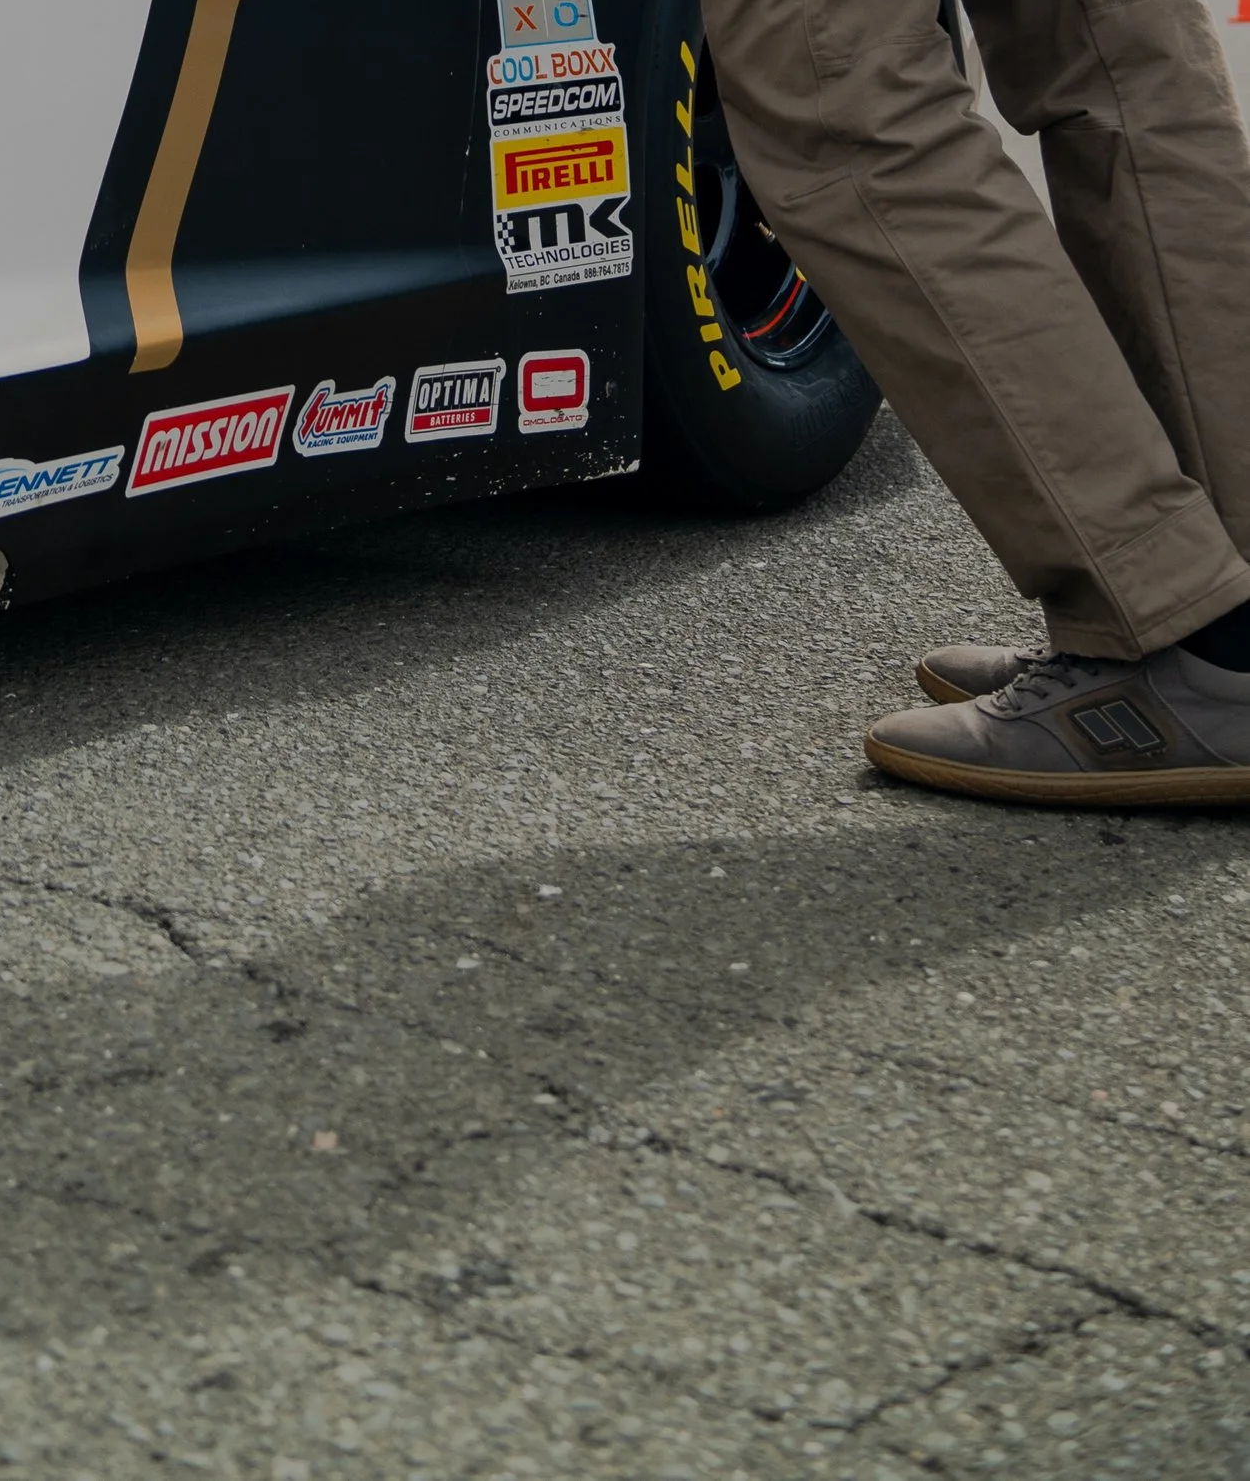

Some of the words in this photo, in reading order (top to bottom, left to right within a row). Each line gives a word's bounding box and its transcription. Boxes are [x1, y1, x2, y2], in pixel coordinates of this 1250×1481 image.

[490, 55, 547, 85] COOL
[551, 47, 615, 78] BOXX
[493, 82, 617, 120] SPEEDCOM
[493, 115, 622, 138] COMMUNICATIONS
[505, 140, 614, 195] PIRELLI
[676, 40, 742, 392] PIRELLI
[505, 238, 631, 270] TECHNOLOGIES
[553, 270, 581, 284] Canada
[418, 376, 490, 410] OPTIMA
[300, 388, 386, 440] SUMMIT
[430, 413, 476, 427] BATTERIES
[523, 414, 584, 426] OMOLOGATO
[141, 406, 279, 476] MISSION
[307, 438, 334, 449] RACING
[336, 432, 379, 445] EQUIPMENT
[1, 485, 67, 509] TRANSPORTATION
[74, 473, 114, 490] LOGISTICS
